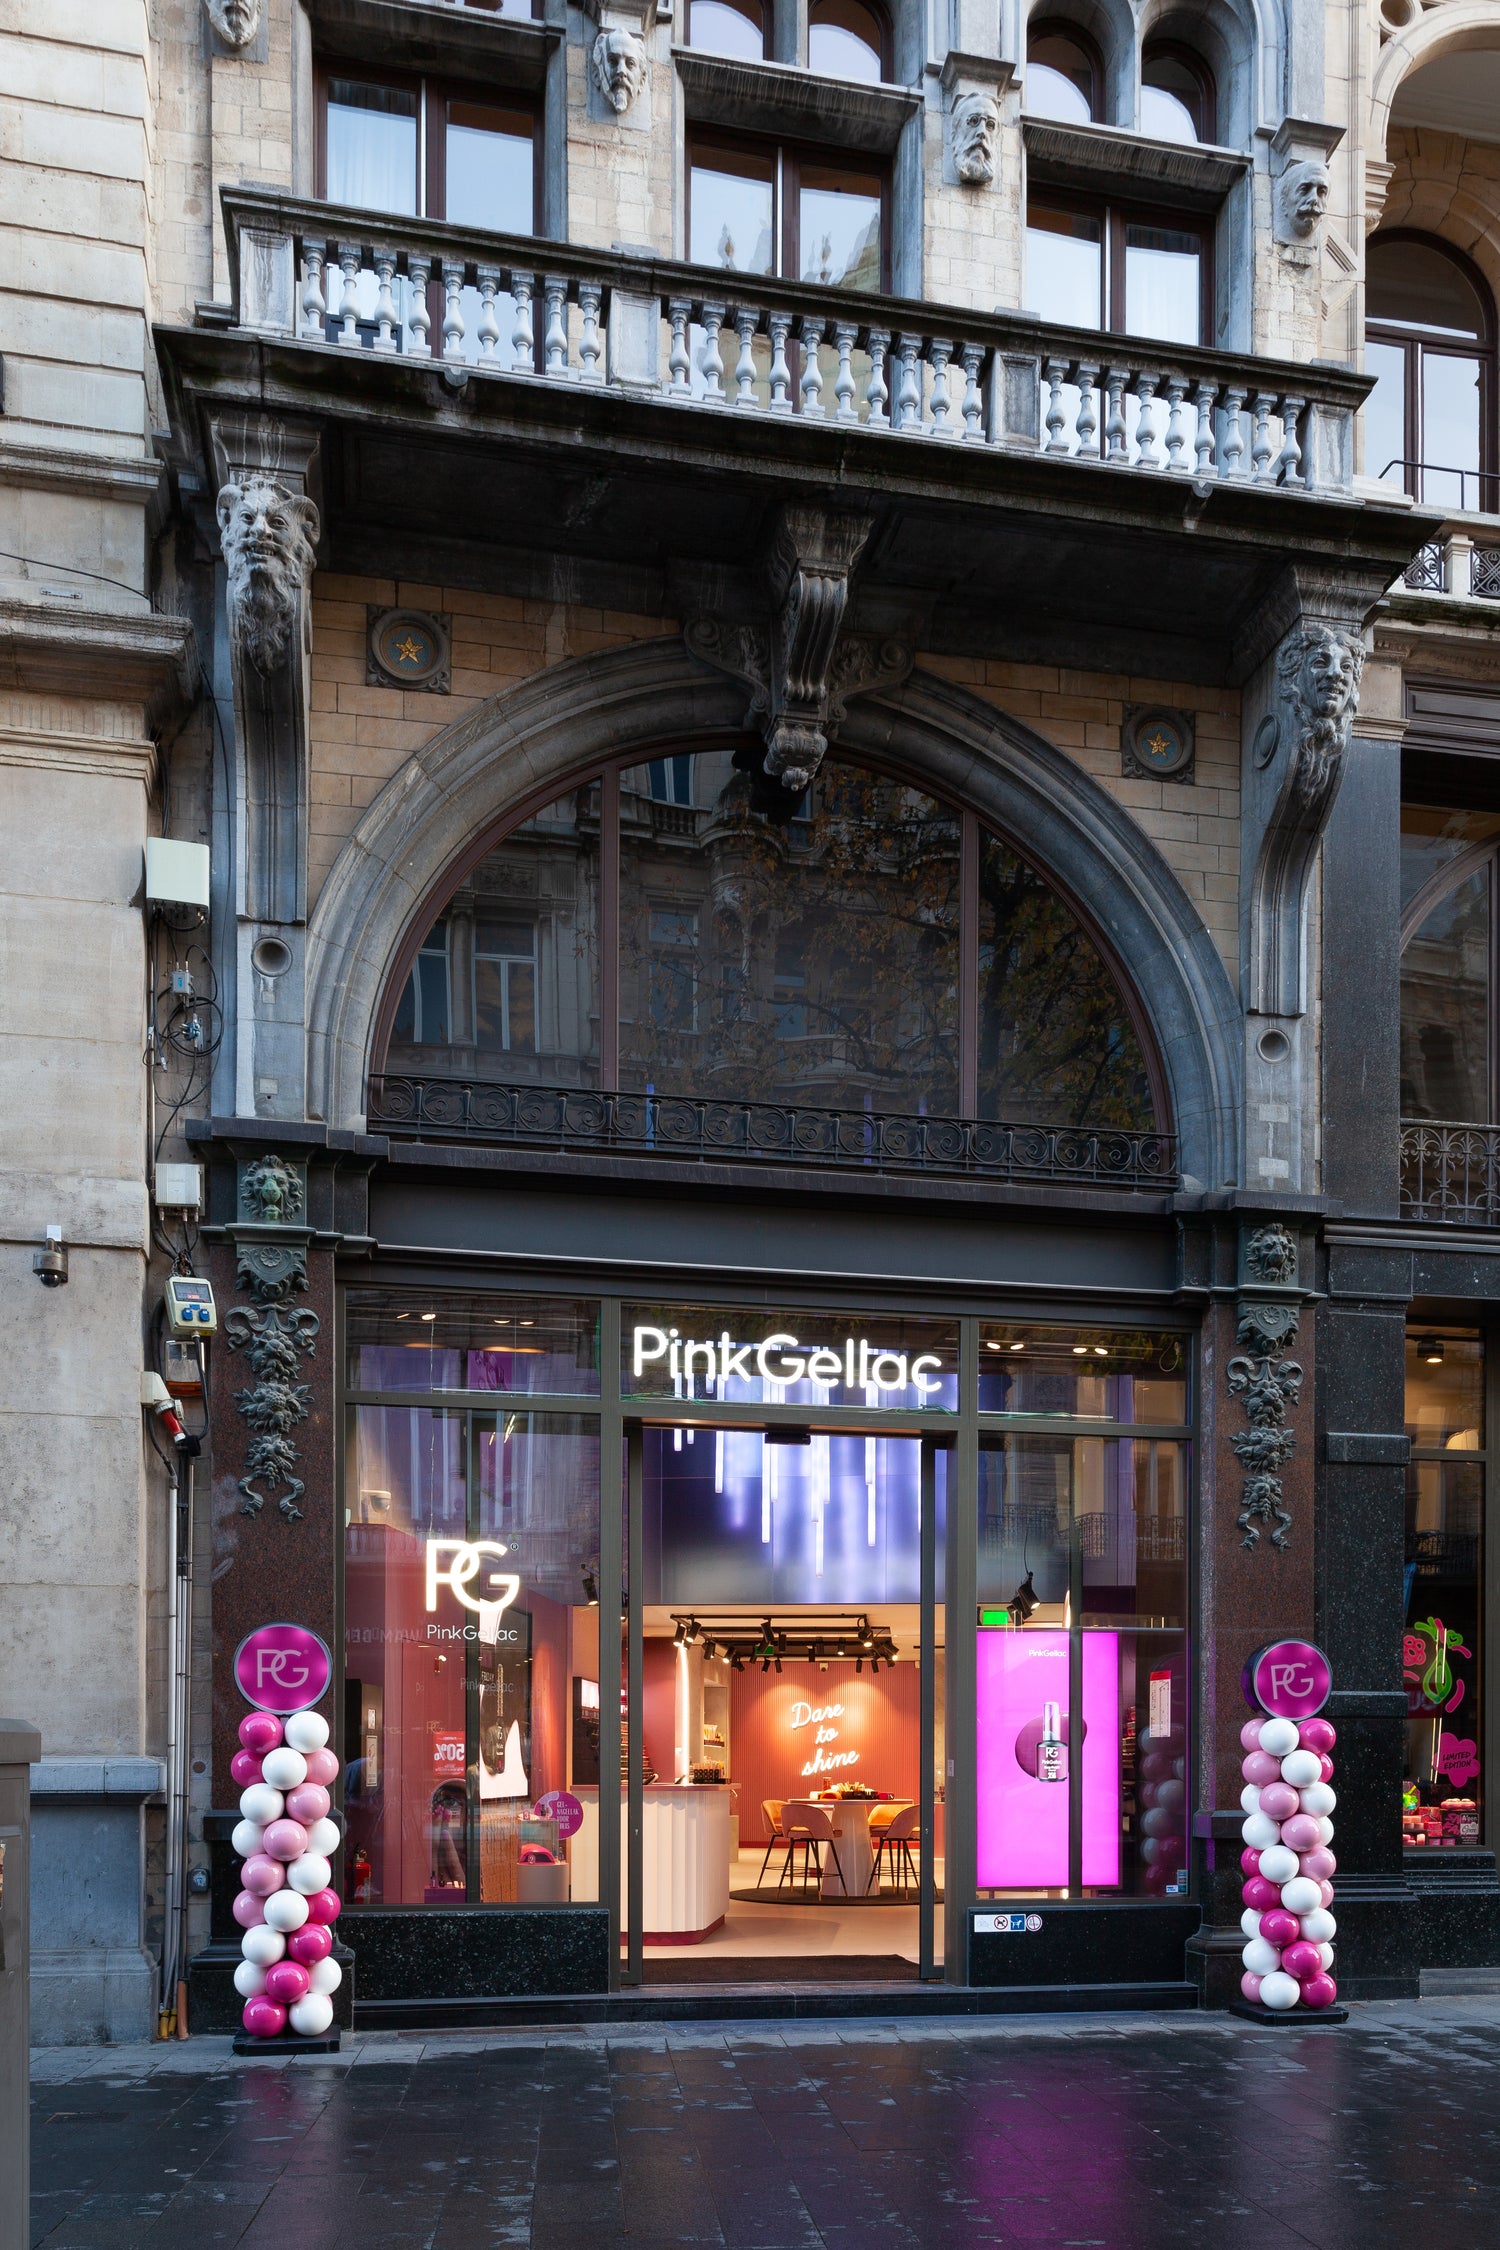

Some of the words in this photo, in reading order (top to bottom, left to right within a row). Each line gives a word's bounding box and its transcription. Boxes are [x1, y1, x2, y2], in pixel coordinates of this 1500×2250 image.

[633, 1325, 943, 1393] PinkGellac
[426, 1539, 520, 1613] PG
[1028, 1648, 1067, 1657] PinkGellac
[256, 1648, 309, 1689] PG
[1270, 1661, 1315, 1700] PG
[791, 1701, 845, 1729] Dare
[815, 1724, 839, 1745] to
[801, 1749, 860, 1777] shine
[1442, 1751, 1471, 1761] LIMITED
[1443, 1760, 1472, 1770] EDITION
